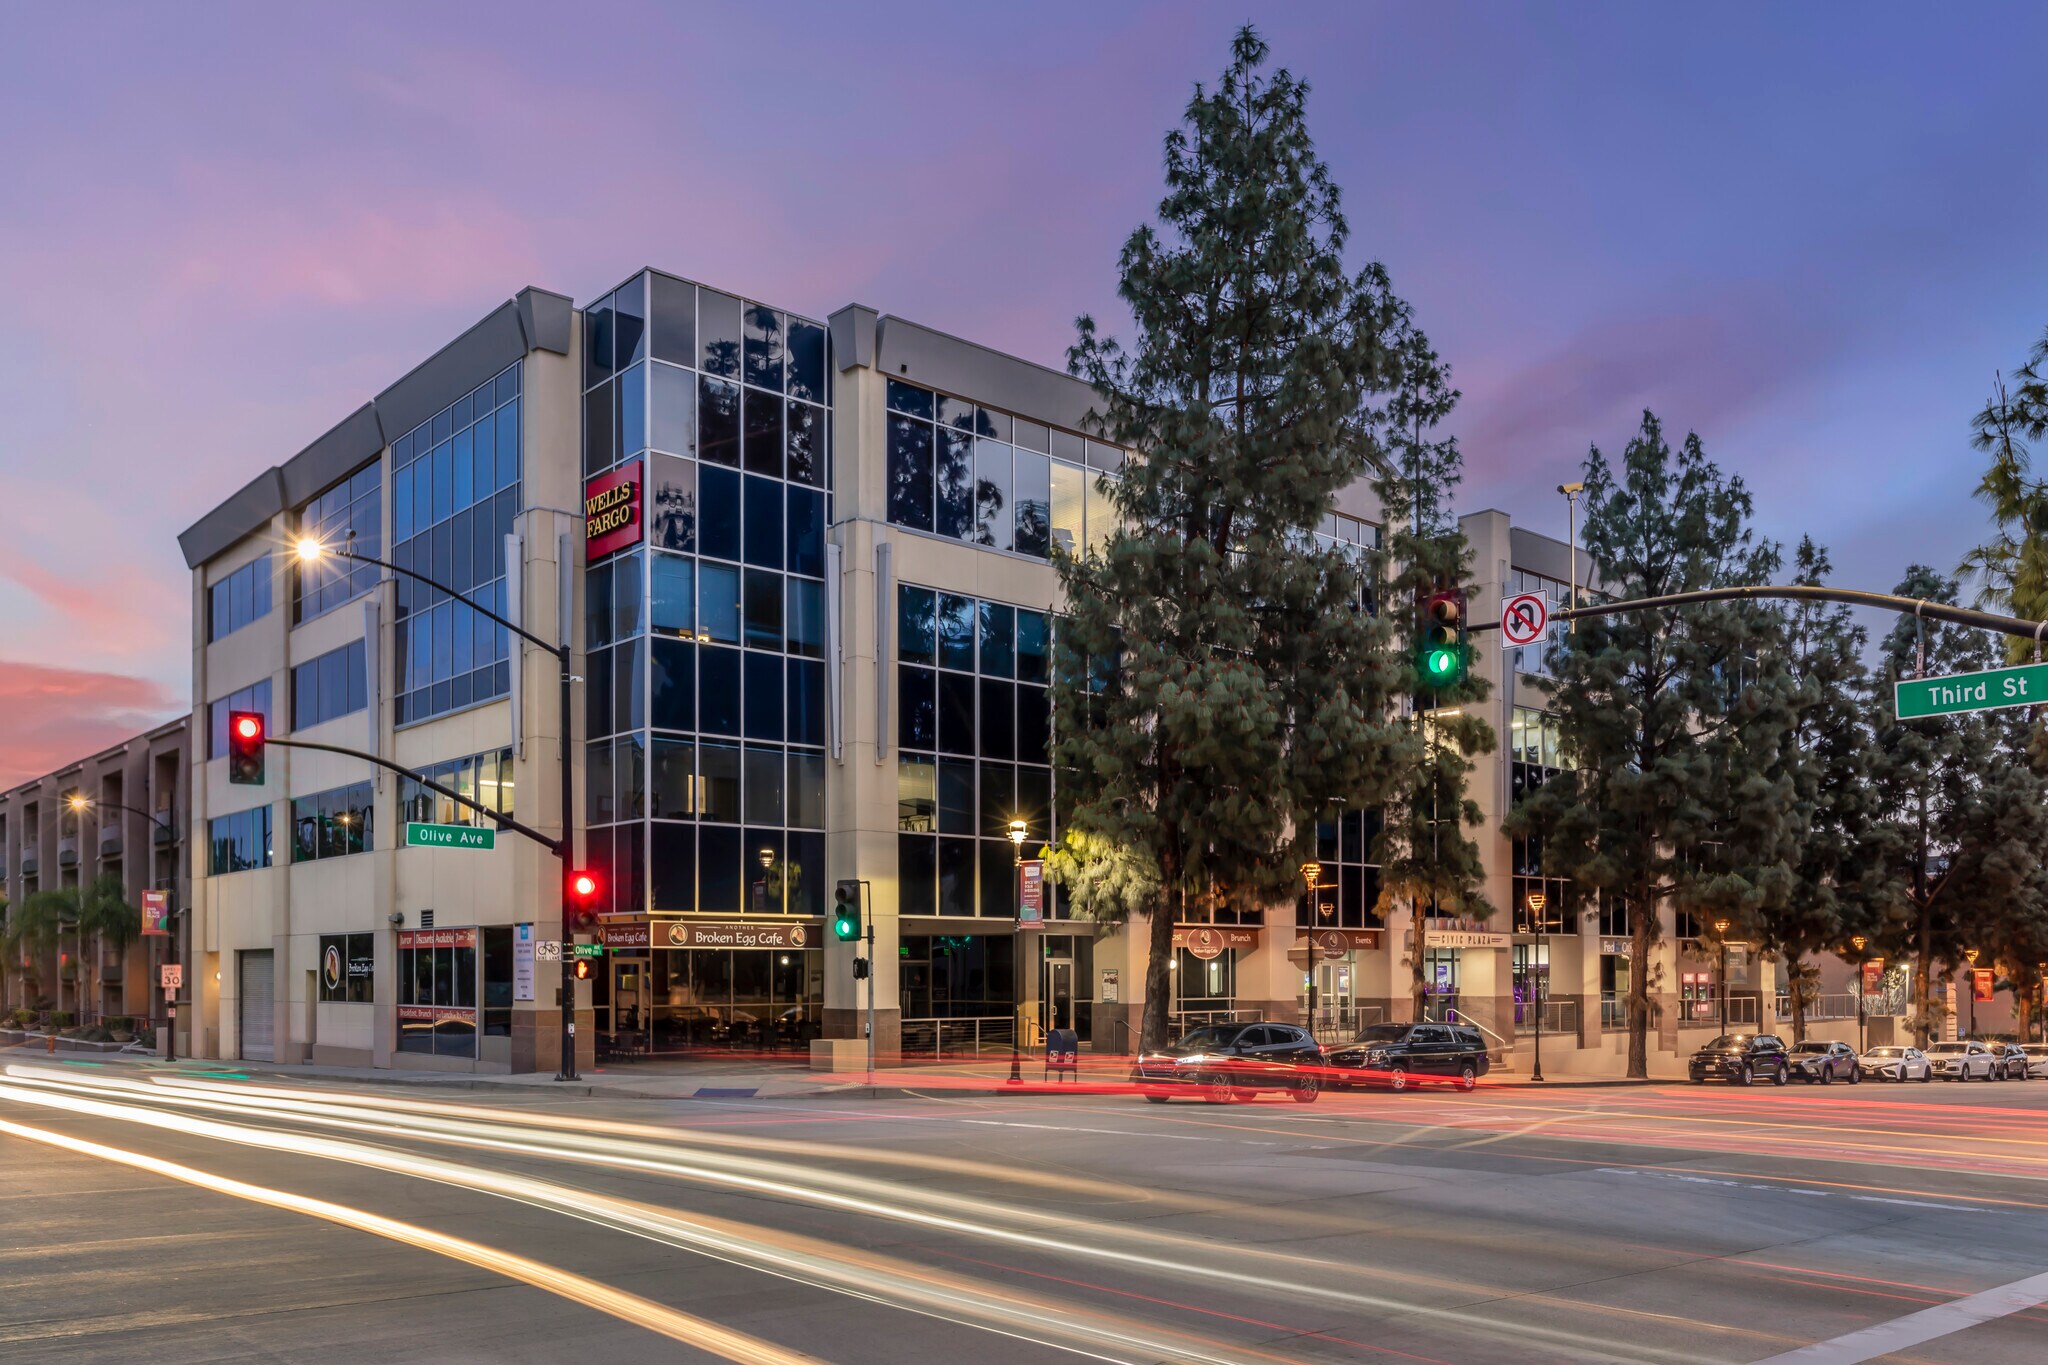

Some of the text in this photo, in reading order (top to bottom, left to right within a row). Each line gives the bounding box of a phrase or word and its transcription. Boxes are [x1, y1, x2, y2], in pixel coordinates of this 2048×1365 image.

[586, 481, 630, 515] WELLS
[587, 505, 630, 539] FARGO
[1928, 676, 2028, 706] Third St
[420, 829, 483, 844] Olive Ave
[416, 934, 434, 944] Discounts
[435, 932, 454, 944] Available
[607, 932, 648, 944] Broken Egg Cafe
[695, 932, 733, 944] Broken
[736, 932, 756, 946] Egg
[1230, 934, 1251, 942] Brunch
[1442, 935, 1490, 944] CIVIC PLAZA
[575, 946, 592, 954] Olive
[164, 976, 180, 984] 30
[418, 1009, 432, 1017] Brunch
[442, 1010, 452, 1019] Lunch
